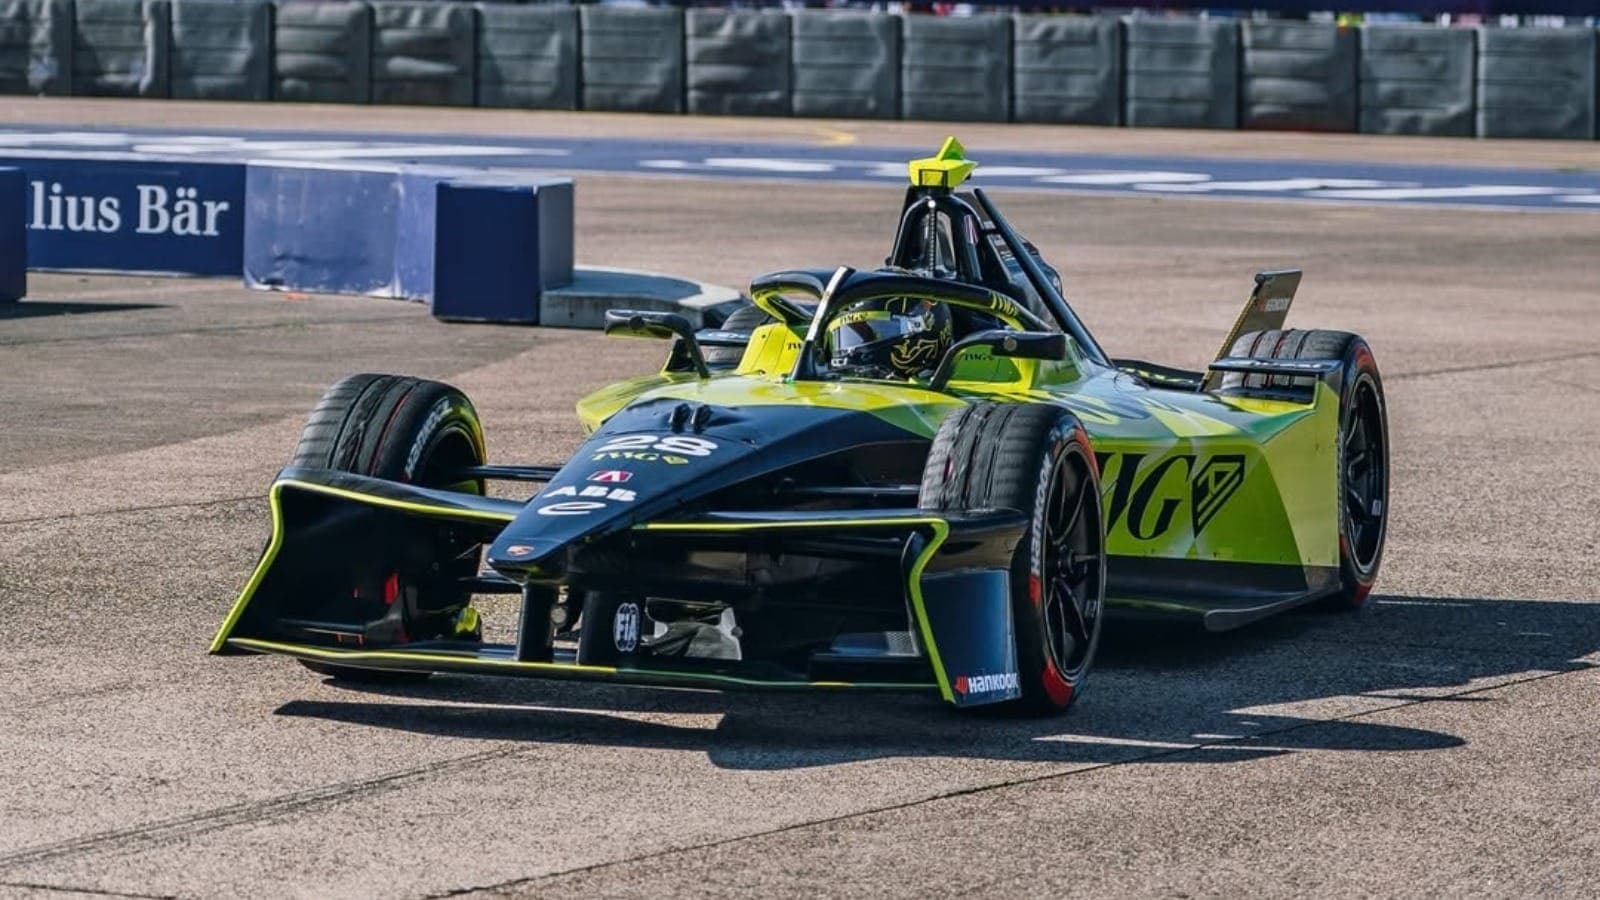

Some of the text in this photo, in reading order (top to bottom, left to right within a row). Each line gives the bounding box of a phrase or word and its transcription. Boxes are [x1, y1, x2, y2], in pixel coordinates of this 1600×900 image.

[30, 181, 229, 236] lius Bär
[595, 435, 718, 456] 28
[543, 486, 637, 501] ABB
[1095, 452, 1195, 540] WG
[616, 613, 637, 641] FIA
